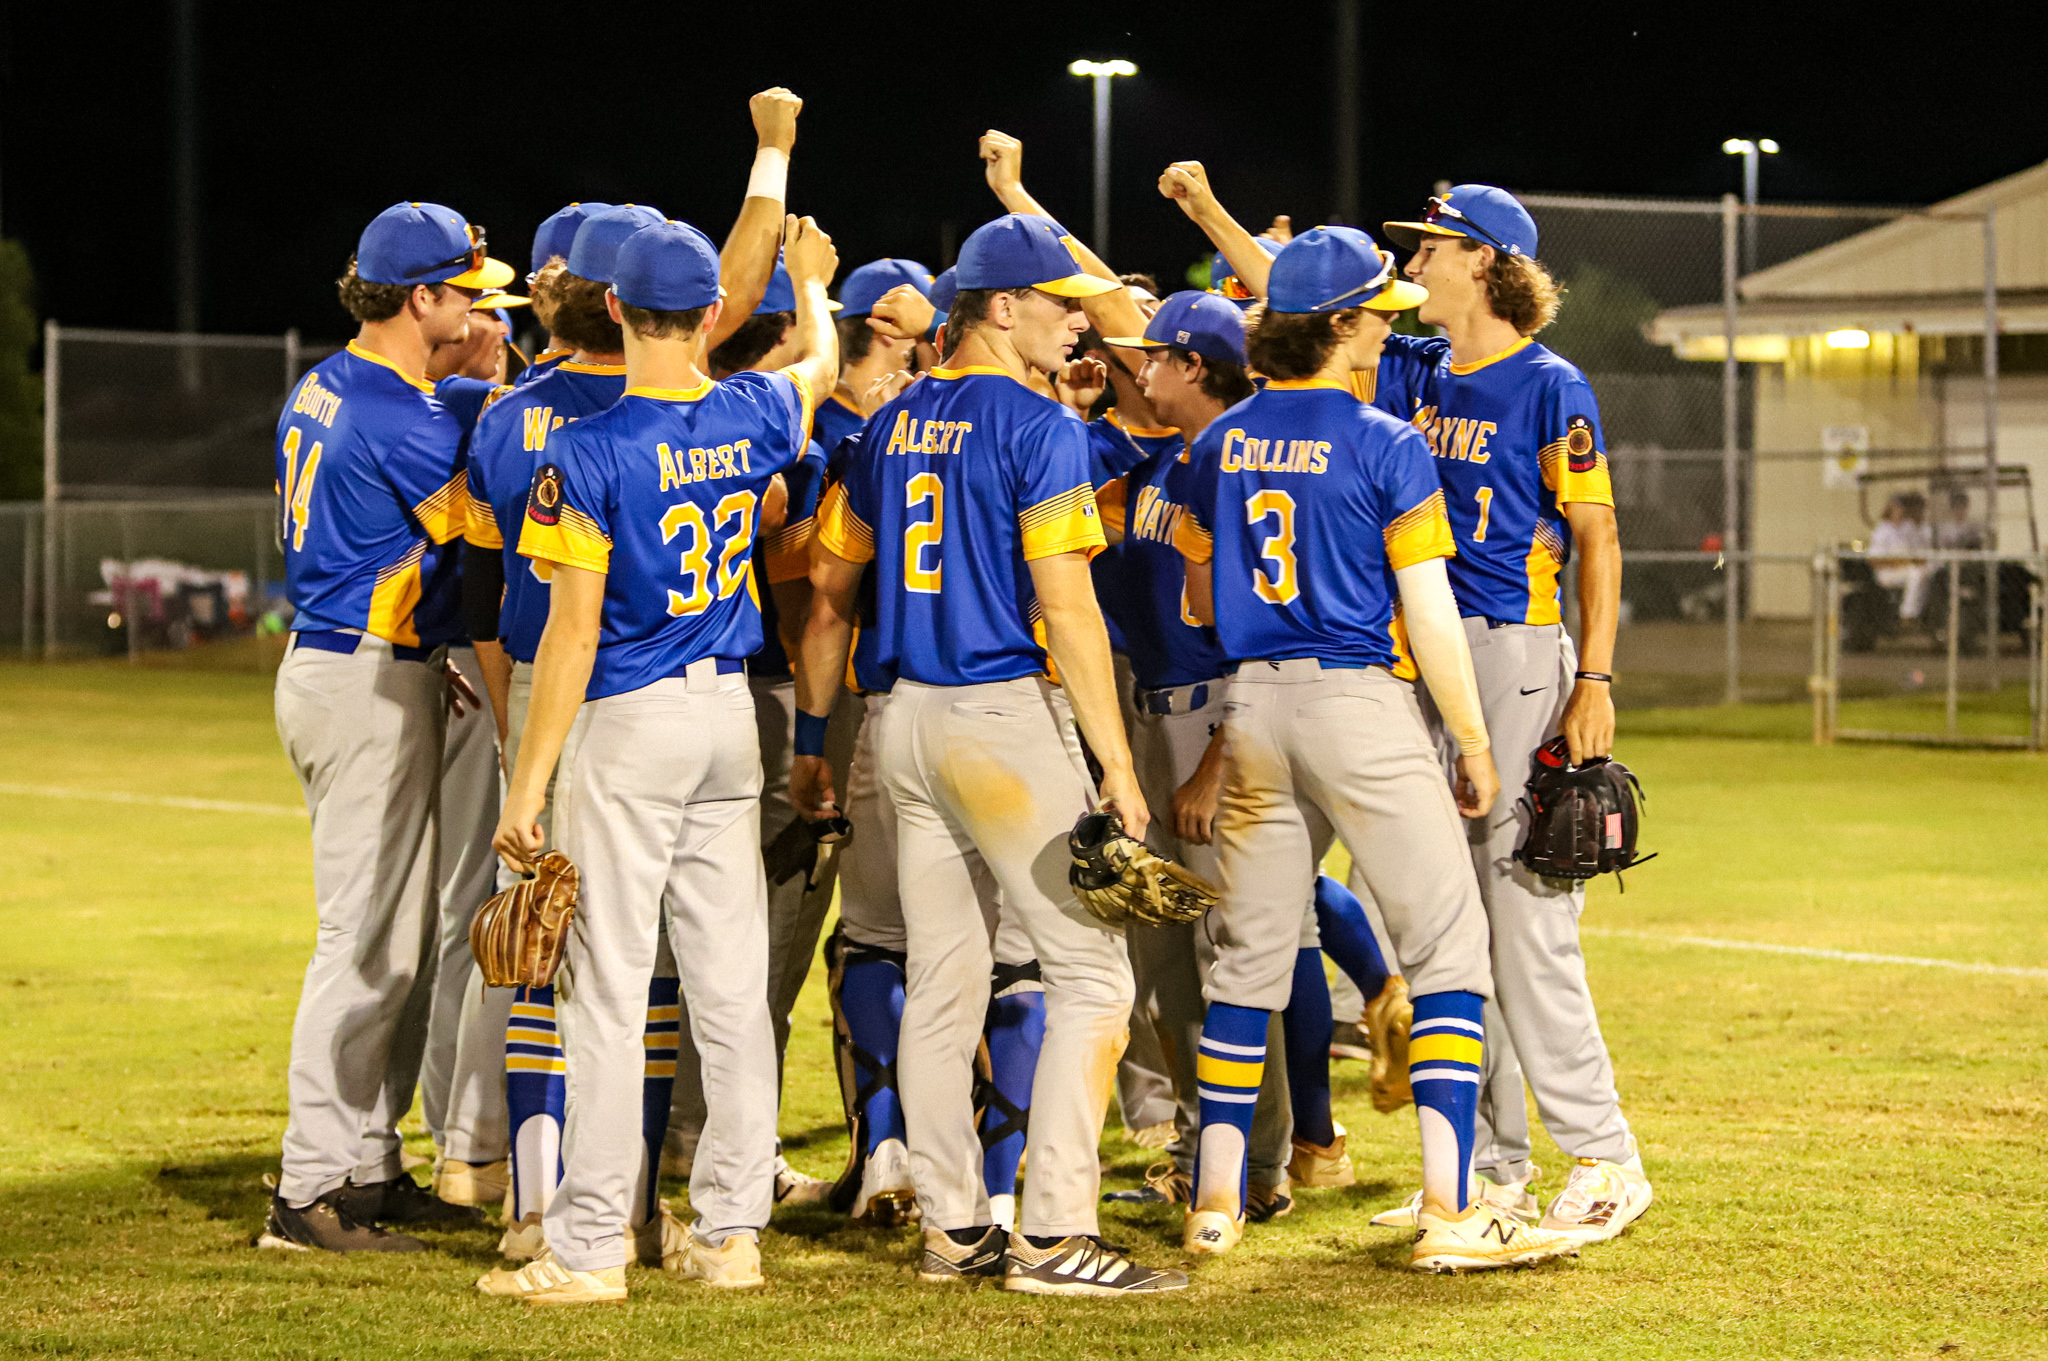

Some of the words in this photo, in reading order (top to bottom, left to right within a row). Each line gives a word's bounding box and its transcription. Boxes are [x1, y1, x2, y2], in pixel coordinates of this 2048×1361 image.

[656, 438, 752, 492] ALBERT
[886, 409, 972, 455] ALBERT
[1219, 428, 1332, 474] COLLINS
[283, 426, 323, 552] 14
[1473, 486, 1494, 543] 1
[657, 488, 758, 618] 32
[904, 472, 944, 594] 2
[1245, 489, 1300, 606] 3
